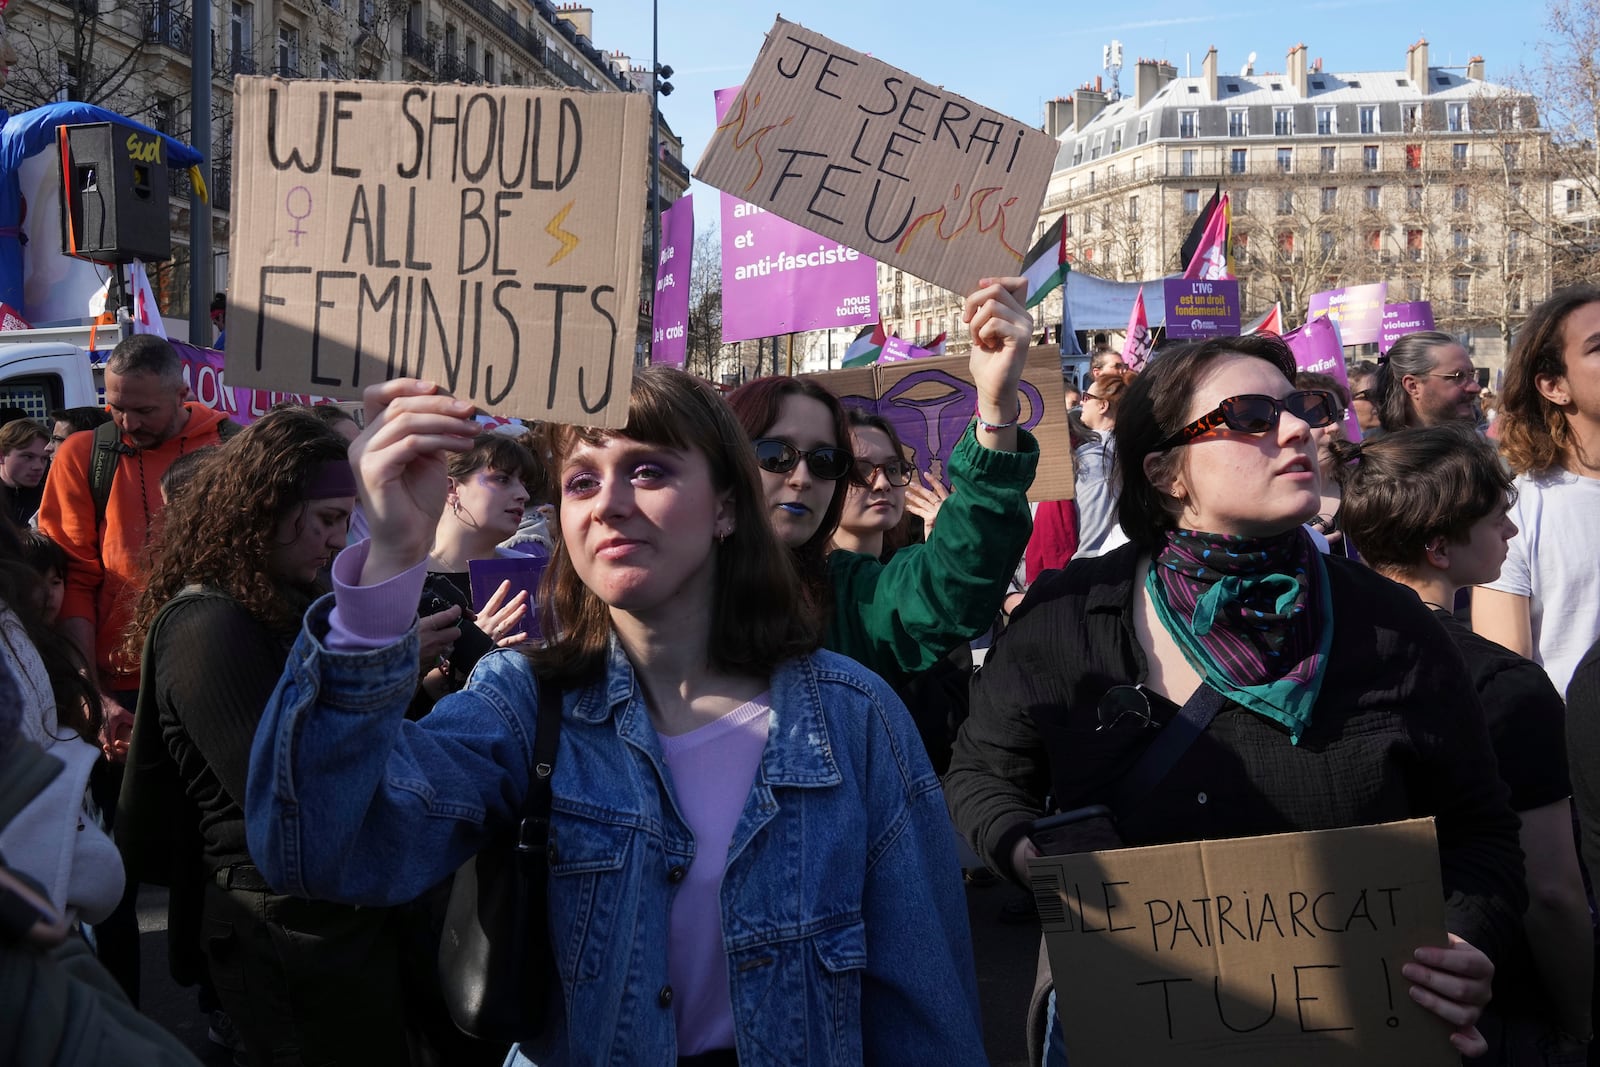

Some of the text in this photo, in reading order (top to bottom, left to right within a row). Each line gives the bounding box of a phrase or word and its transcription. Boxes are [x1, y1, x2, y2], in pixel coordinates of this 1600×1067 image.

[777, 36, 859, 100] JE
[126, 133, 161, 165] Sud
[267, 87, 583, 192] WE SHOULD
[850, 118, 922, 182] LE
[769, 148, 916, 244] FEU
[342, 184, 524, 276] ALL BE
[734, 229, 755, 249] et
[735, 245, 860, 280] anti-fasciste
[843, 296, 870, 307] nous
[1180, 295, 1225, 305] est un droit
[1192, 283, 1213, 294] L'IVG
[836, 304, 871, 317] toutes
[1175, 305, 1226, 316] fondamental
[1382, 311, 1398, 319] Les
[1383, 320, 1420, 330] violeurs
[256, 265, 617, 414] FEMINISTS
[666, 321, 684, 340] crois
[1075, 881, 1136, 933] LE
[1135, 957, 1400, 1040] TUE !
